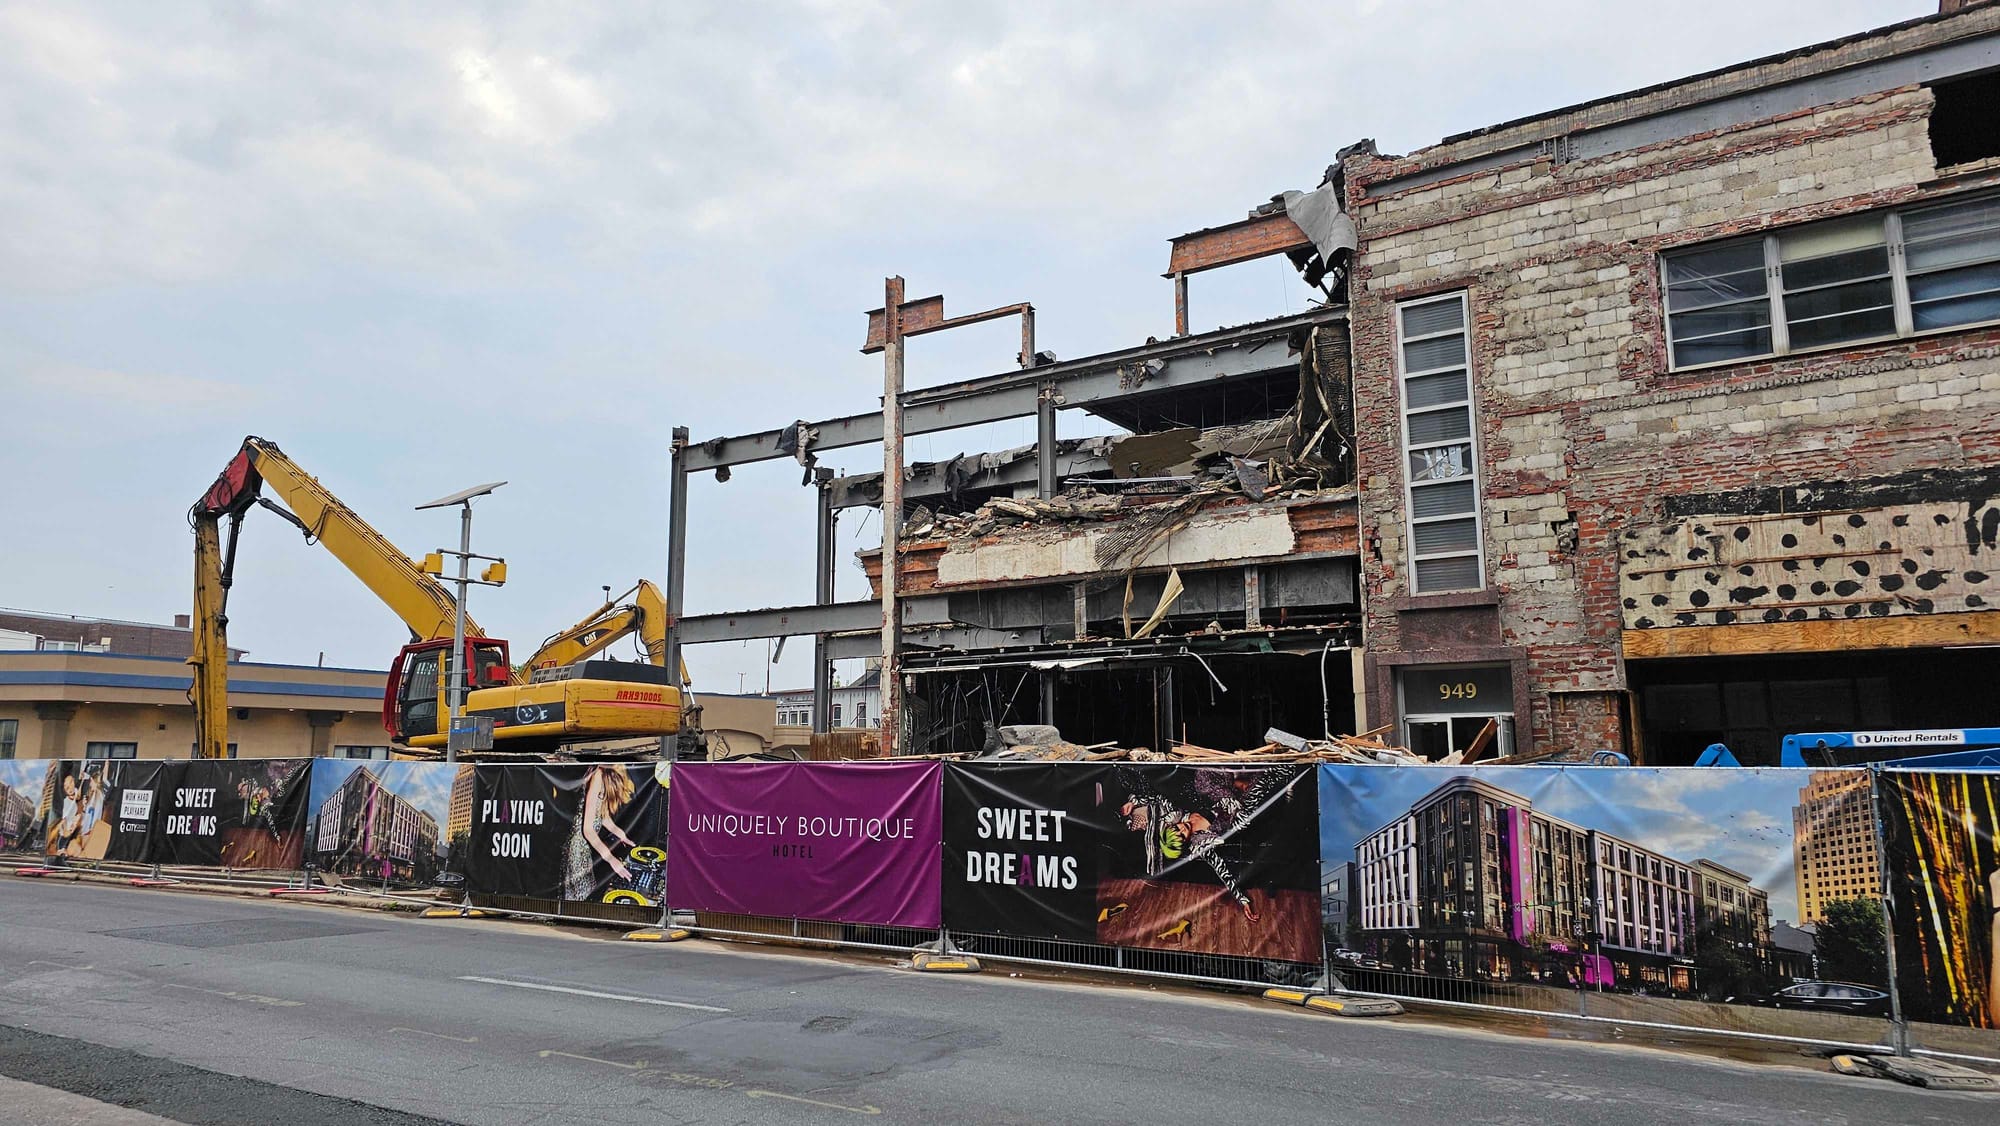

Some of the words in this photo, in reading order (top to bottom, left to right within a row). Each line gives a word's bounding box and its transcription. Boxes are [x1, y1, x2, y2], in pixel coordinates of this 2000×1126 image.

[584, 632, 597, 646] CAT
[1439, 682, 1477, 700] 949
[1873, 734, 1912, 743] United
[1915, 733, 1958, 742] Rentals
[175, 787, 216, 808] SWEET
[481, 799, 544, 825] PLAYING
[166, 815, 217, 836] DREAMS
[688, 813, 788, 837] UNIQUELY
[798, 816, 914, 842] BOUTIQUE
[977, 806, 1067, 842] SWEET
[491, 832, 531, 859] SOON
[772, 844, 814, 859] HOTEL
[966, 850, 1078, 890] DREAMS
